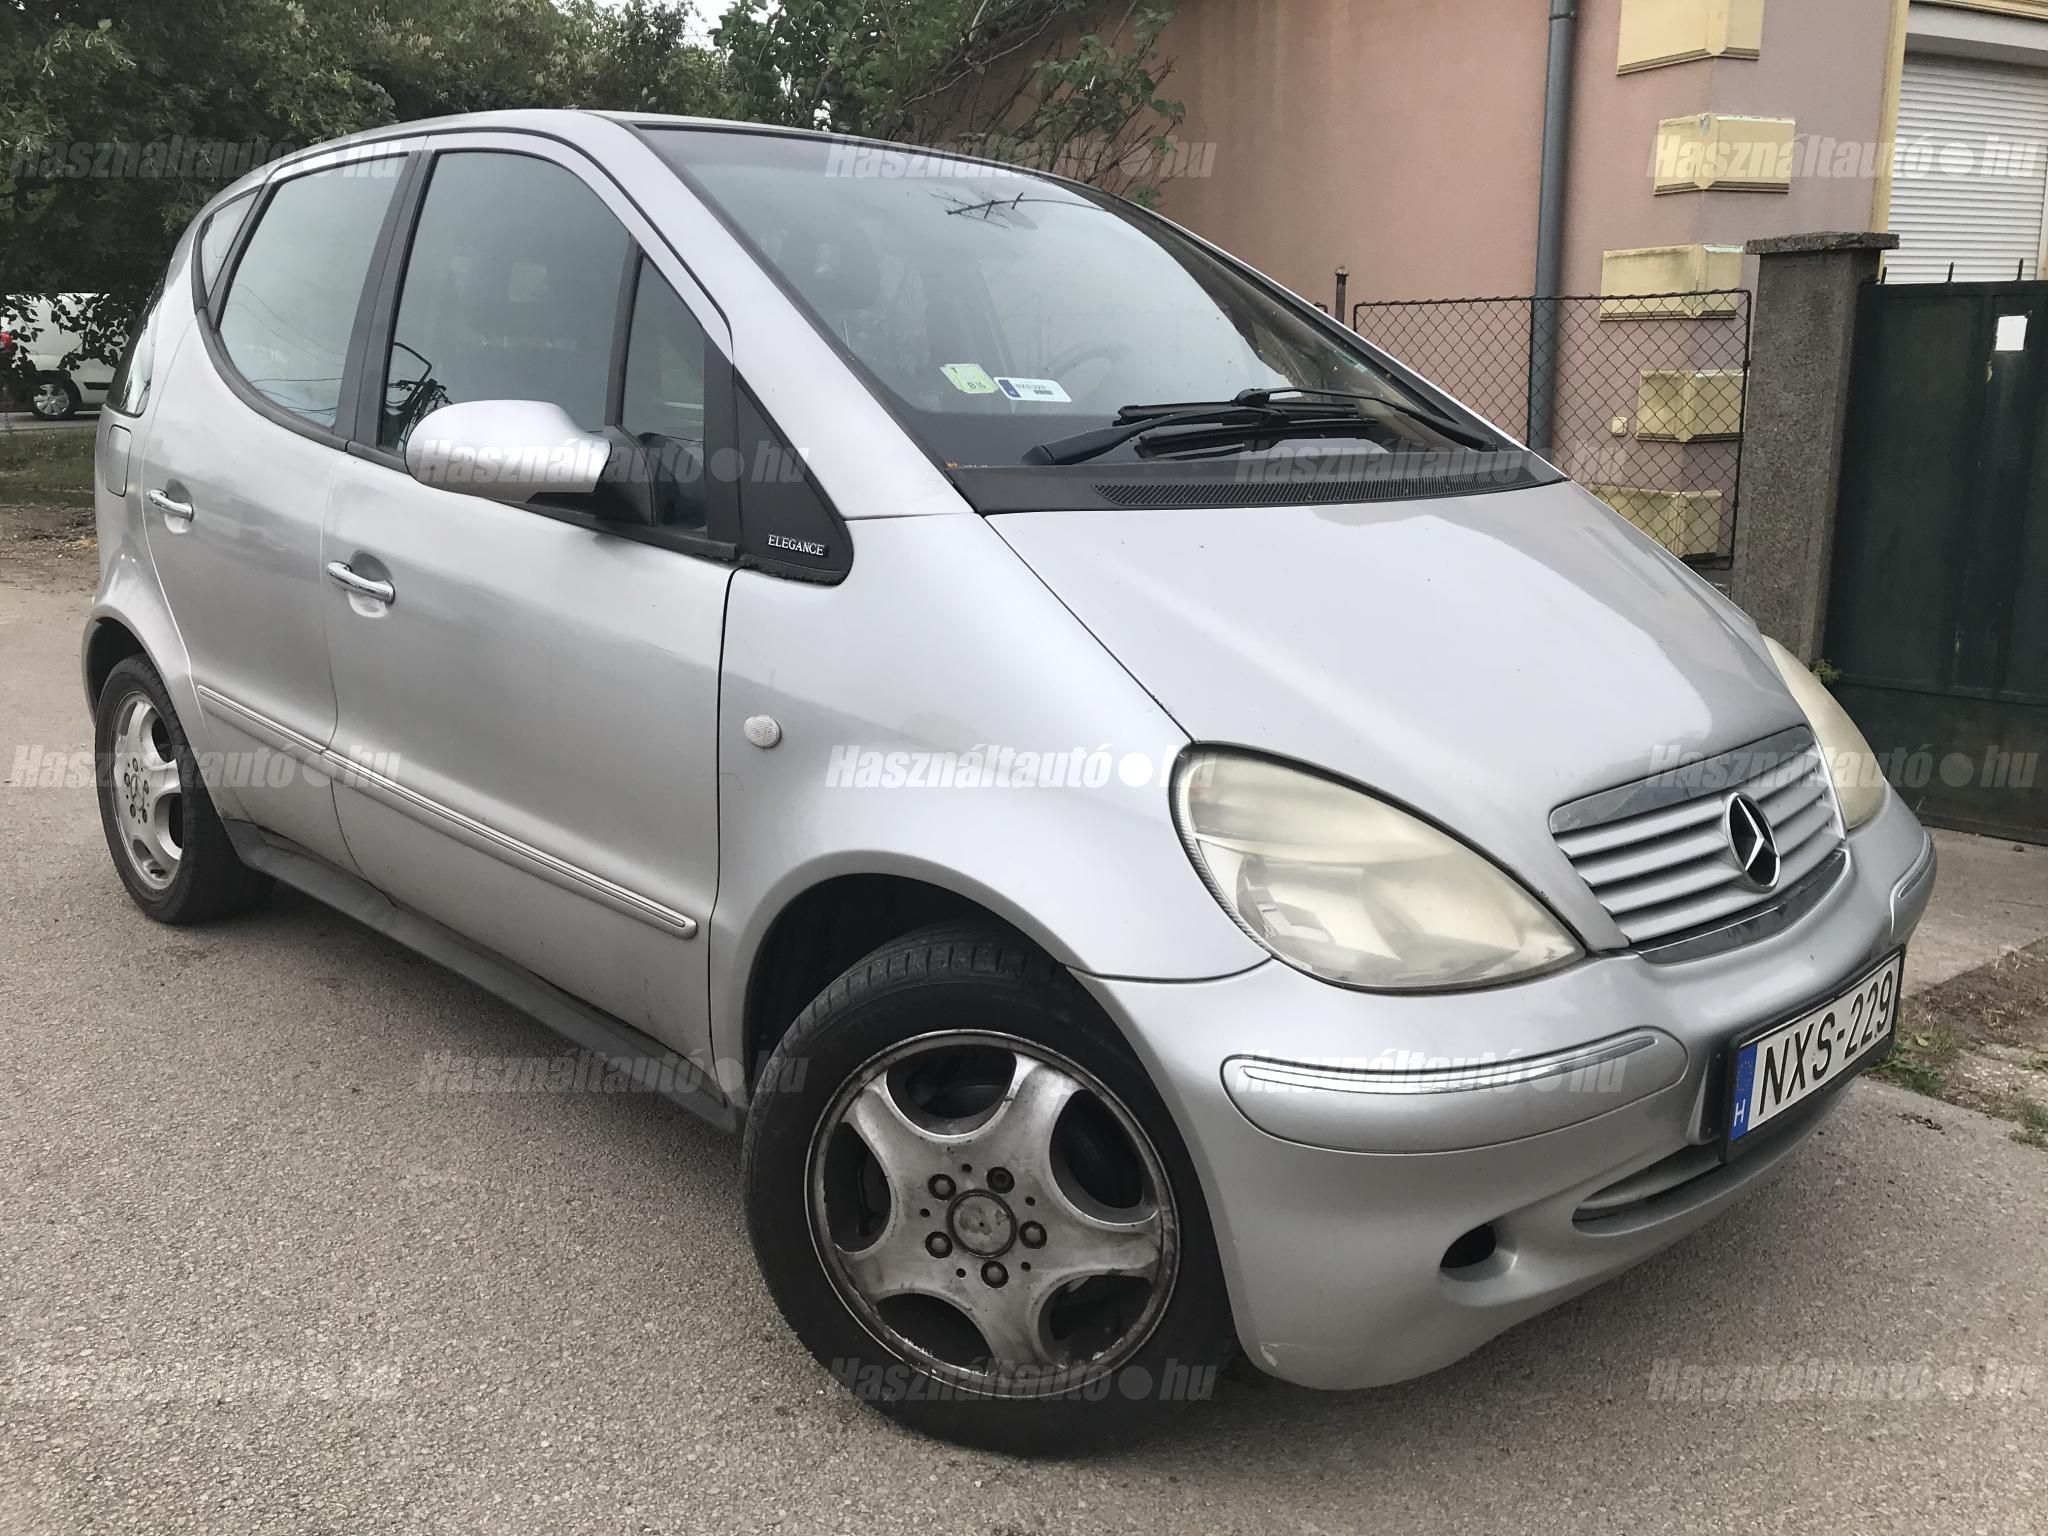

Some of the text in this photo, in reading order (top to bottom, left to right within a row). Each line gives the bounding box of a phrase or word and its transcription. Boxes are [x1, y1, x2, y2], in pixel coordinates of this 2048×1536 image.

[768, 534, 825, 556] ELEGANCE
[1758, 970, 1893, 1117] NXS-229
[1733, 1098, 1747, 1128] H
